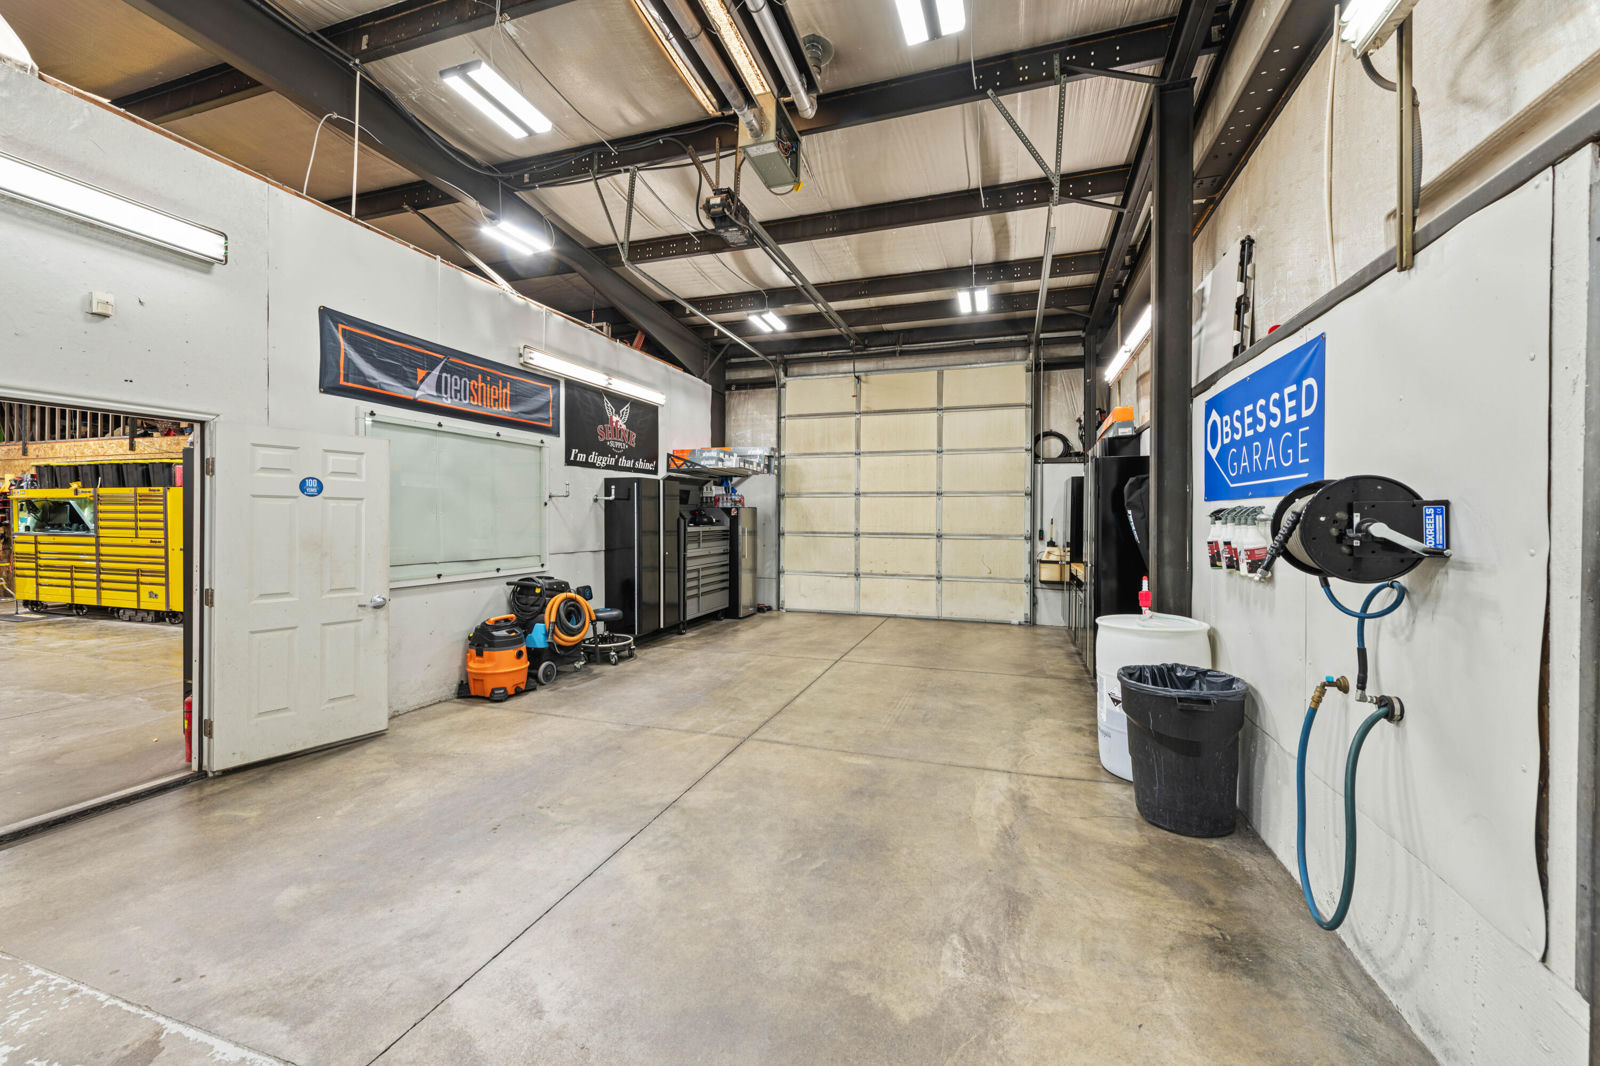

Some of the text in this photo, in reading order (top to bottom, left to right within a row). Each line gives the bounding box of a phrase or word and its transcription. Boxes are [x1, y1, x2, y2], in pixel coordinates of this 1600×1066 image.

[441, 372, 511, 412] geoshield
[597, 415, 636, 447] SHINE
[1207, 377, 1319, 460] OBSESSED
[569, 448, 656, 471] I'm diggin' that shine!
[609, 440, 626, 449] SUPPLY
[1228, 426, 1310, 477] GARAGE
[306, 479, 317, 487] 100
